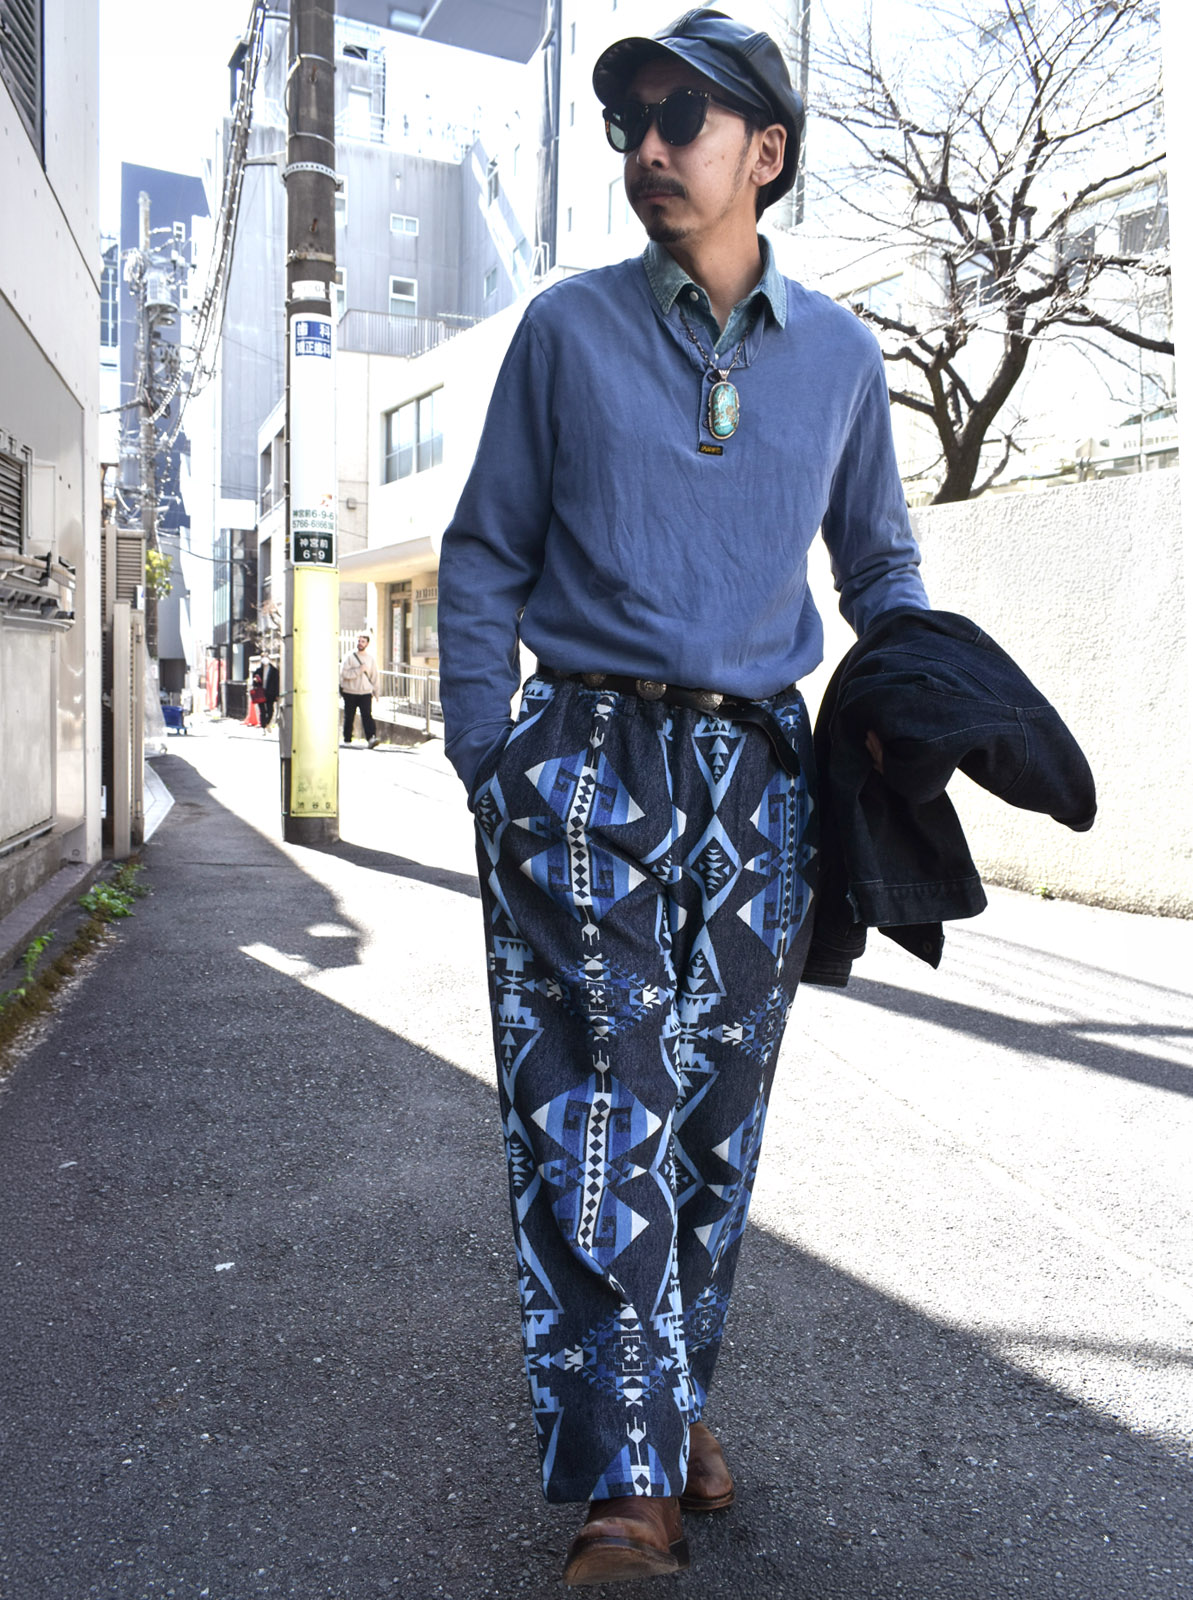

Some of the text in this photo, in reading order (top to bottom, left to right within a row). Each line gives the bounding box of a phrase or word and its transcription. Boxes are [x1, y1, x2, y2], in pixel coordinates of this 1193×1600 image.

[300, 538, 329, 549] 神宮前
[303, 550, 326, 560] 6-9
